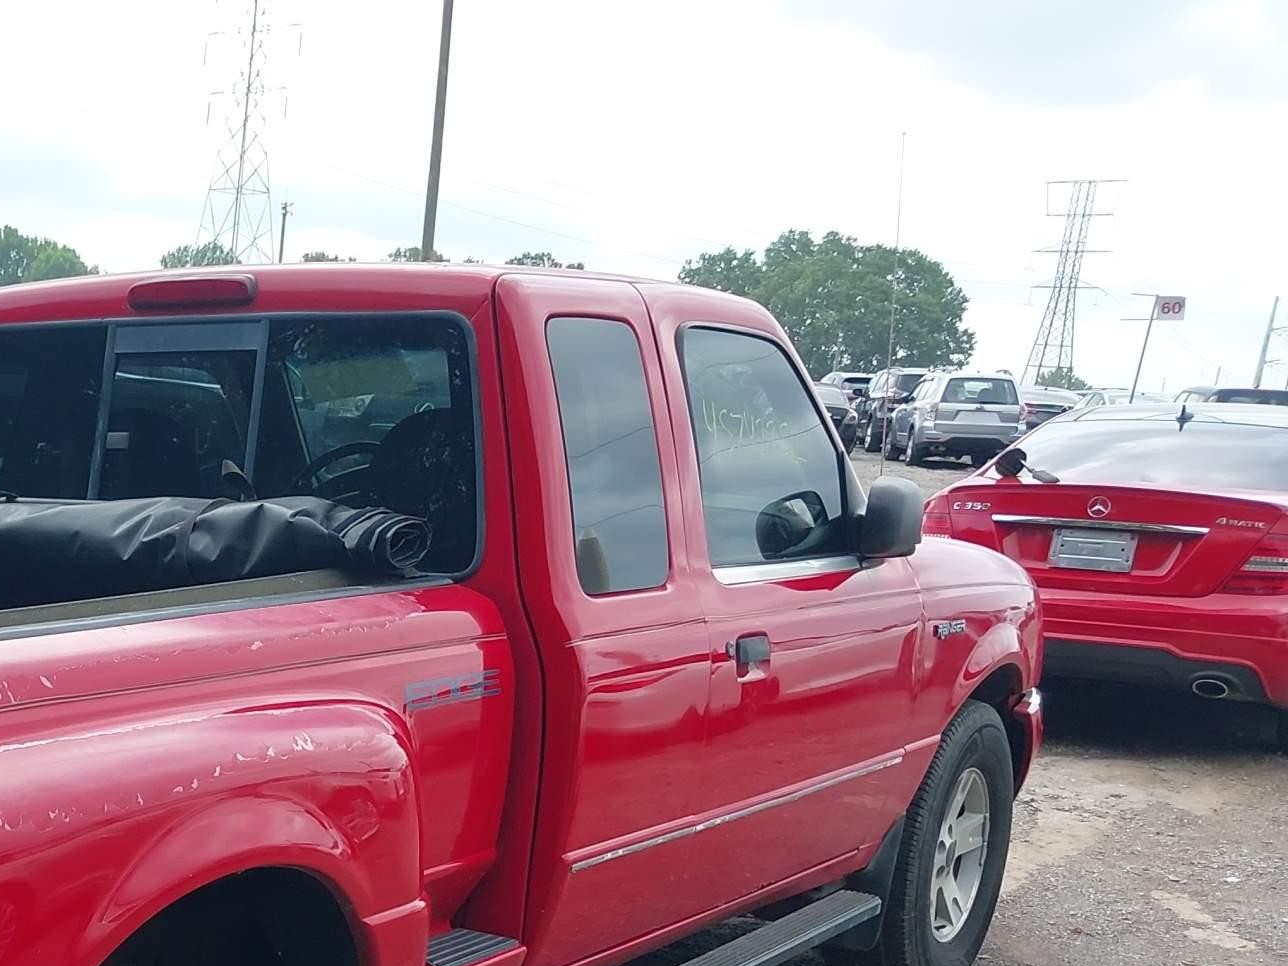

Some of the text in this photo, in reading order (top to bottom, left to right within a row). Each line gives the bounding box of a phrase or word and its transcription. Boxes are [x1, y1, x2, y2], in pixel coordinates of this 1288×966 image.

[1160, 302, 1182, 314] 60
[953, 501, 992, 511] C 350
[406, 669, 501, 711] EDGE
